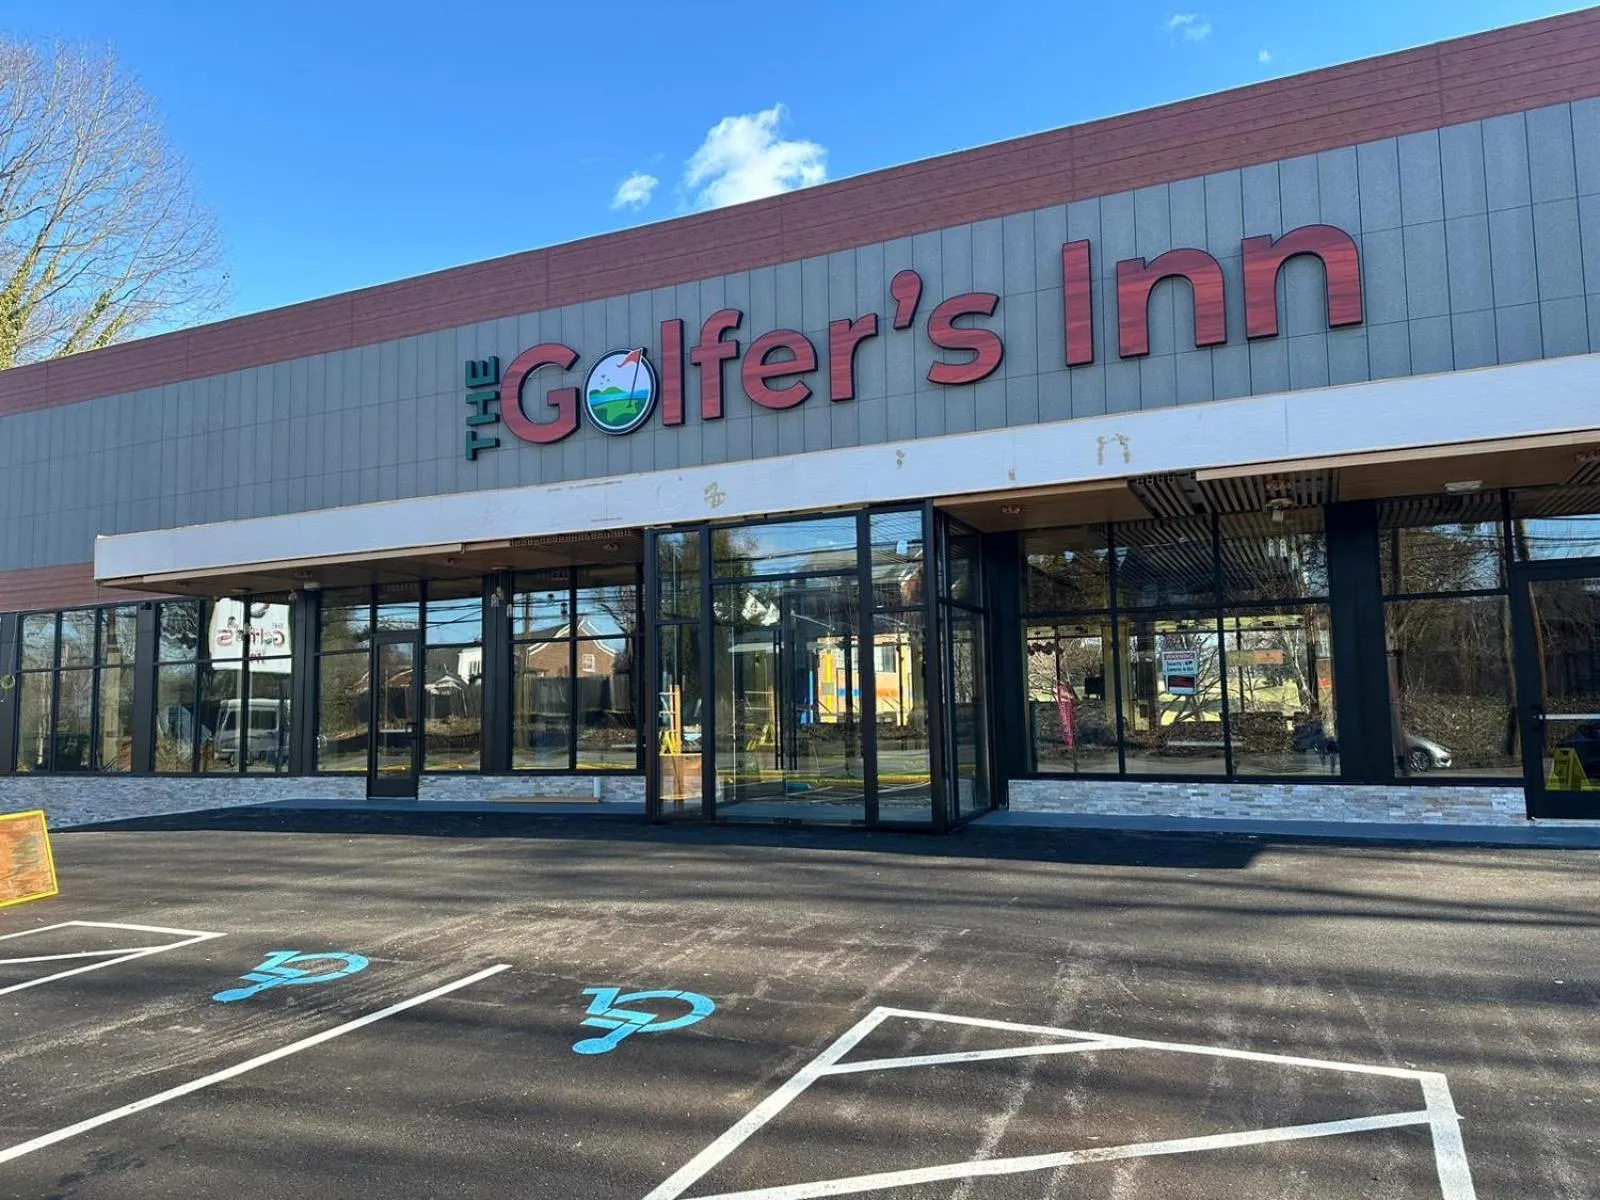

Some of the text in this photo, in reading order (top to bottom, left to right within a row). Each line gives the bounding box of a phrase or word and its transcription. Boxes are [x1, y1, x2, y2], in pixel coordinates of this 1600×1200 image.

[465, 355, 501, 461] THE
[500, 223, 1364, 445] Golfer's Inn
